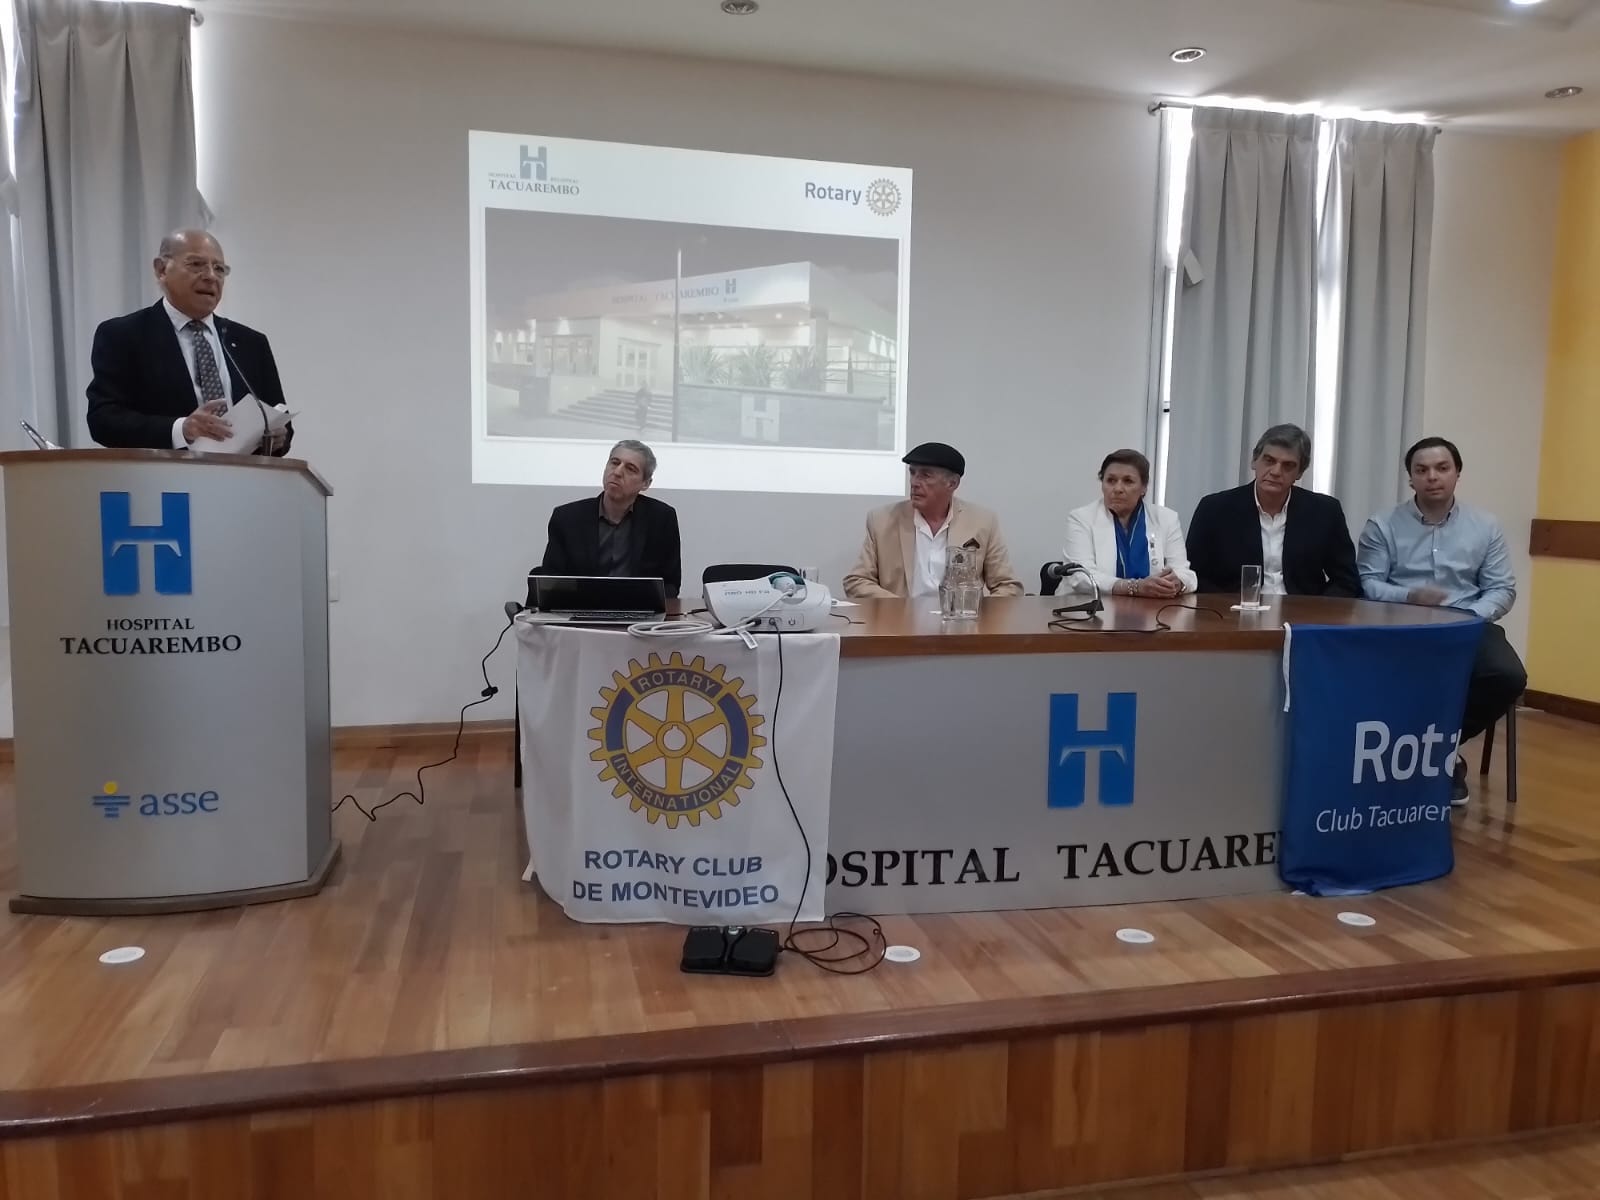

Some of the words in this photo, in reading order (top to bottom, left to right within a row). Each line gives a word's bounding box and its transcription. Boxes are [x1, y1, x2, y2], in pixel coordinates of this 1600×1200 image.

[488, 179, 580, 196] TACUAREMBO
[804, 181, 862, 206] Rotary
[106, 617, 195, 632] HOSPITAL
[60, 634, 242, 655] TACUAREMBO
[637, 671, 717, 694] ROTARY
[613, 756, 740, 811] INTERNATIONAL
[139, 790, 219, 816] asse
[1316, 807, 1363, 833] Club
[584, 849, 686, 875] ROTARY
[692, 856, 763, 876] CLUB
[1057, 831, 1282, 880] TACUARE
[573, 880, 602, 902] DE
[611, 880, 779, 909] MONTEVIDEO
